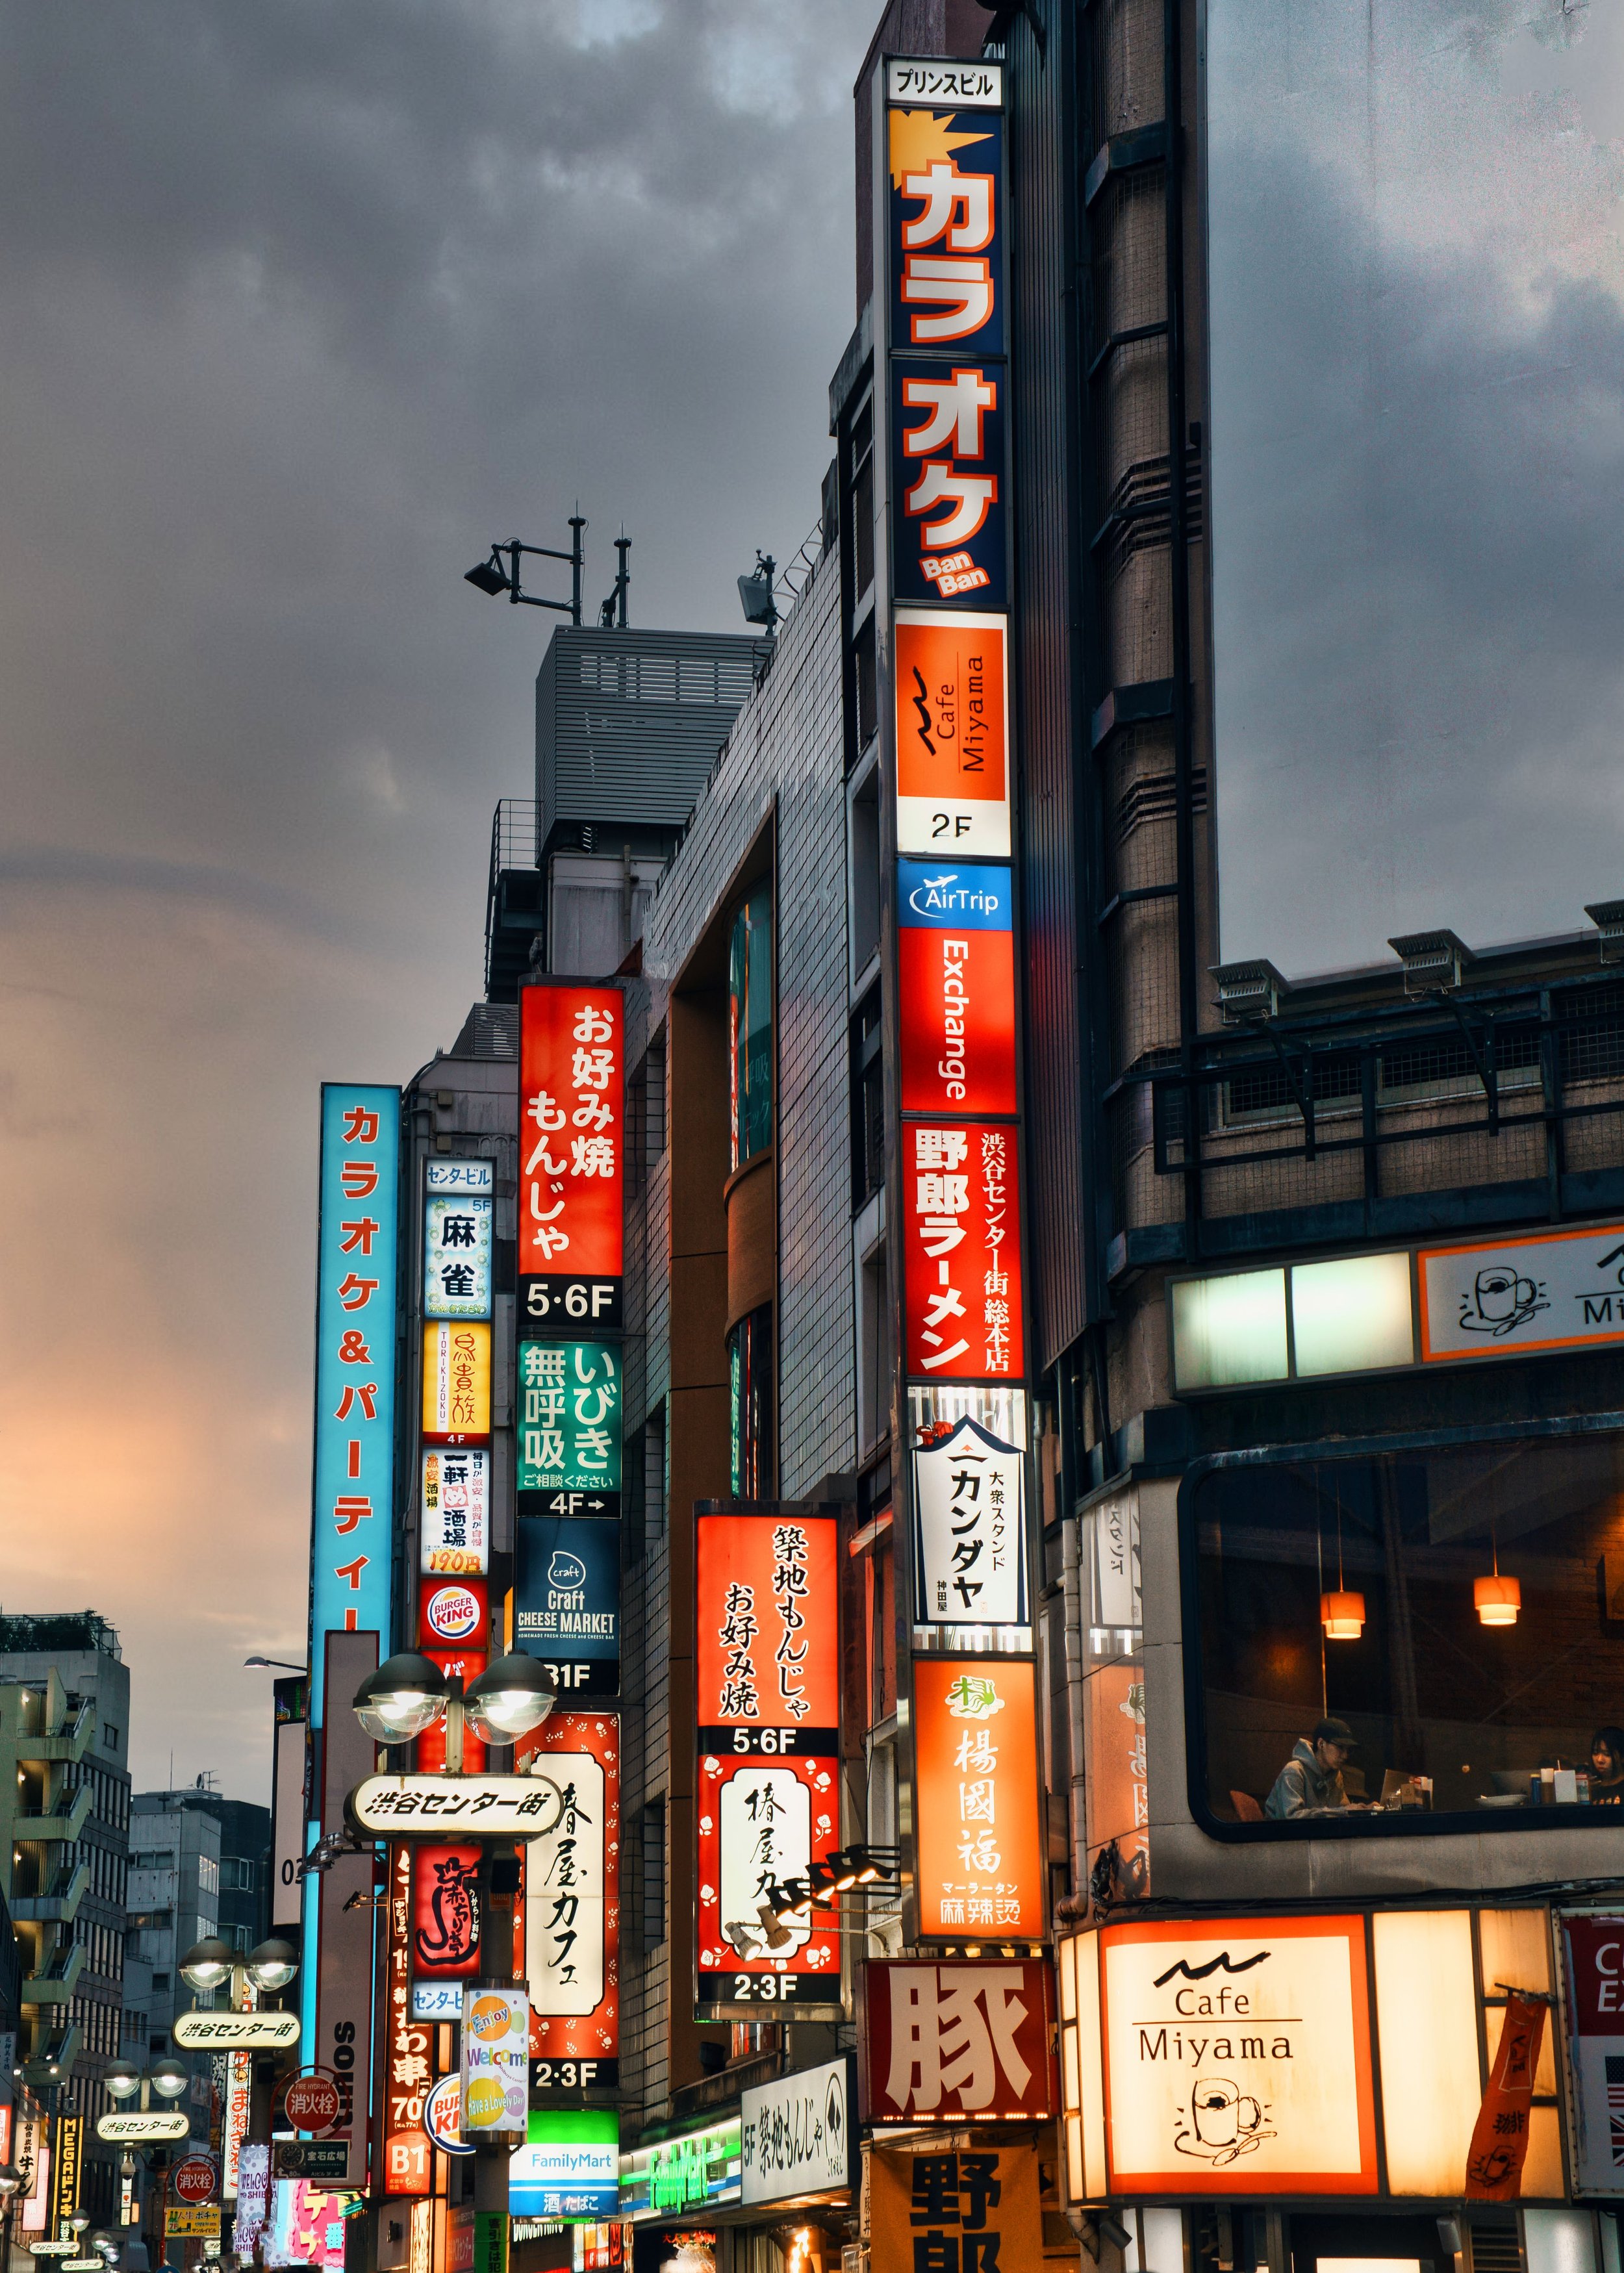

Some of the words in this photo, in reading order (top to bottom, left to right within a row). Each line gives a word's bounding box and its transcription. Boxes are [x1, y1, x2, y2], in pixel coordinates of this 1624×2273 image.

[897, 70, 995, 96] プリンスビル
[902, 160, 996, 550] カラオケ
[920, 552, 972, 580] Ban
[937, 568, 988, 596] Ban
[936, 683, 956, 739] Cafe
[963, 655, 989, 772] Miyama
[932, 813, 972, 838] 2F
[924, 889, 999, 915] AirTrip
[938, 939, 970, 1100] Exchange
[570, 1005, 615, 1178] お好み焼
[428, 1166, 491, 1186] センタービル
[525, 1090, 570, 1260] もんじゃ
[472, 1199, 491, 1212] 5F
[440, 1214, 476, 1297] 麻雀
[915, 1130, 971, 1371] 野郎ラーメン
[452, 1332, 476, 1424] 鳥貴族
[524, 1345, 566, 1470] 無呼吸
[574, 1347, 617, 1469] いびき
[523, 1473, 613, 1488] ご相談ください
[550, 1493, 585, 1515] 4F
[989, 1471, 1006, 1571] 大衆スタンド
[950, 1469, 984, 1609] カンダヤ
[430, 1551, 481, 1571] 190円
[553, 1566, 580, 1579] craft
[435, 1597, 472, 1615] BURGER
[548, 1590, 585, 1610] Craft
[937, 1580, 948, 1612] 神田屋
[436, 1606, 474, 1628] KING
[518, 1611, 557, 1627] CHEESE
[561, 1613, 615, 1634] MARKET
[772, 1525, 810, 1721] 築地もんじゃ
[719, 1582, 760, 1720] お好み焼
[364, 1791, 552, 1816] 渋谷センター街
[954, 1729, 1002, 1874] 楊國福
[744, 1781, 788, 1901] 椿屋カ
[941, 1882, 1018, 1895] マーラータン
[414, 1991, 463, 2010] センター
[1174, 1986, 1250, 2016] Cafe
[182, 2022, 296, 2037] 渋谷センター街
[472, 2007, 509, 2035] Enjoy
[885, 1966, 1033, 2113] 豚
[1139, 2028, 1294, 2068] Miyama
[467, 2047, 527, 2067] Welcome
[498, 2064, 512, 2079] Shibuya
[290, 2092, 335, 2115] 消火栓
[434, 2096, 460, 2116] BUR
[468, 2094, 483, 2116] Have
[490, 2094, 512, 2109] Lovely
[101, 2119, 184, 2133] 渋谷センター街
[434, 2113, 460, 2137] KI
[759, 2097, 823, 2179] 築地もんじゃ
[307, 2151, 346, 2161] 宝石広場
[391, 2144, 425, 2174] B1
[744, 2124, 756, 2168] 5F
[60, 2118, 77, 2217] MEGAドンキ
[531, 2153, 612, 2171] FamilyMart
[179, 2173, 211, 2189] 消火栓
[247, 2190, 277, 2200] SHIBA
[543, 2193, 561, 2213] 酒
[565, 2194, 599, 2211] たばこ
